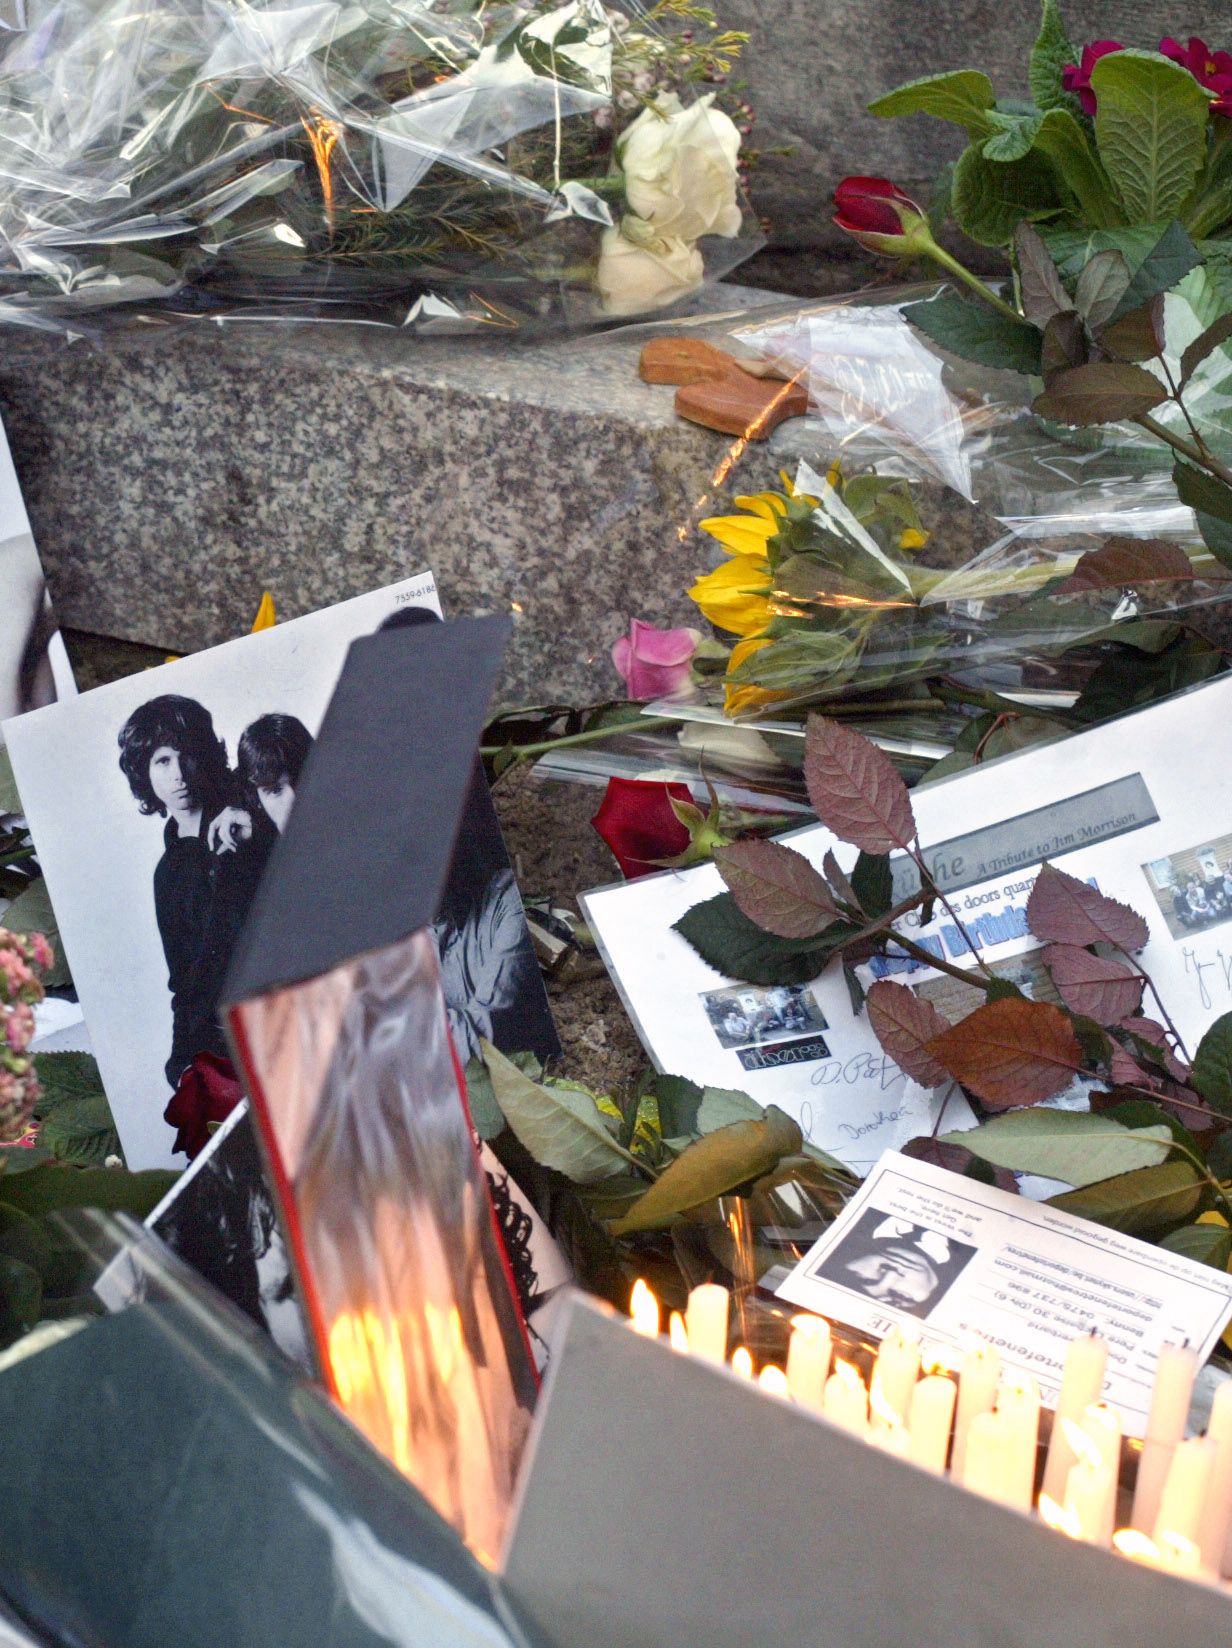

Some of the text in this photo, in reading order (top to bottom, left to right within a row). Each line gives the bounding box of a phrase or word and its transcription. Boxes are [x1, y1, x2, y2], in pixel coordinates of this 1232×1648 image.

[988, 847, 1033, 871] Tribute
[1036, 843, 1050, 855] to
[1077, 812, 1136, 840] Morrison
[964, 889, 1000, 910] doors
[1004, 877, 1035, 901] quar
